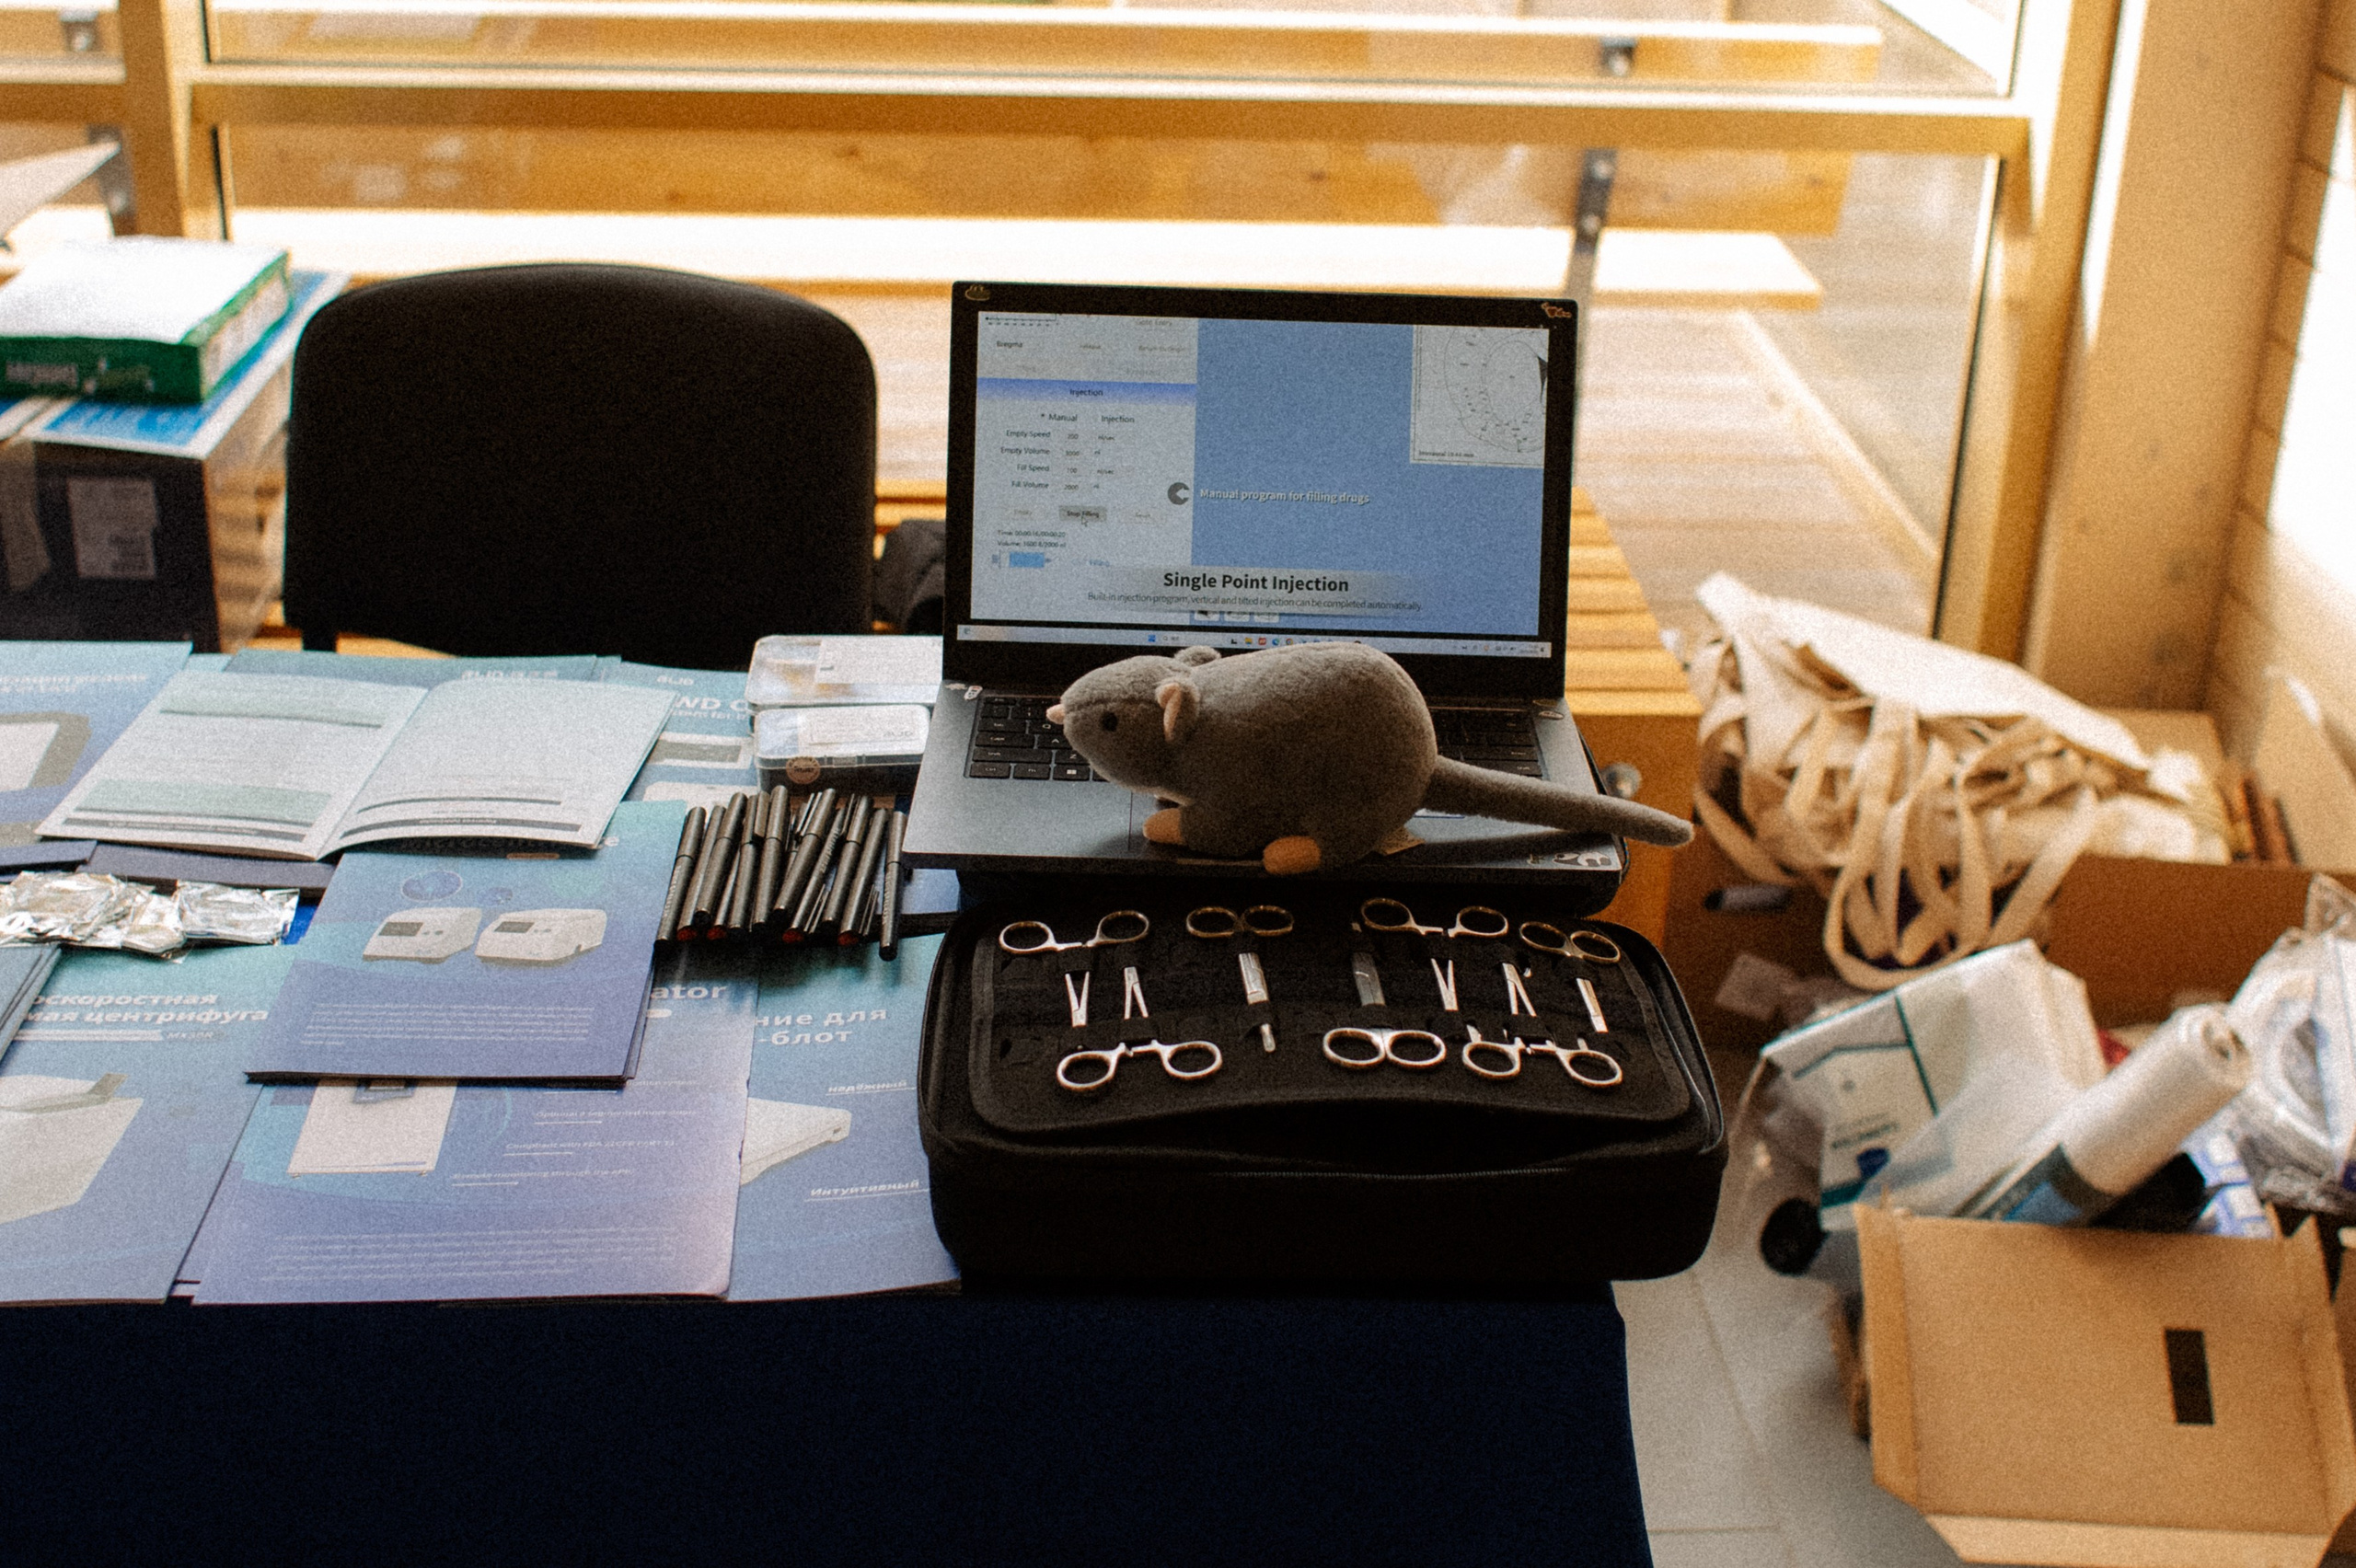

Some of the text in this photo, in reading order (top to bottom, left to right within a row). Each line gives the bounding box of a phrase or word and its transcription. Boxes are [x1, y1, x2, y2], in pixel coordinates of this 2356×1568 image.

[1069, 388, 1103, 398] Injection
[1048, 413, 1135, 424] Manual Injection
[1006, 430, 1028, 438] Empty
[1029, 431, 1051, 439] Speed
[1000, 446, 1022, 455] Empty
[1200, 489, 1370, 504] Manual program for filling drugs
[1163, 571, 1349, 594] Single Point Injection
[1117, 594, 1152, 604] injection
[1191, 595, 1220, 605] vertical
[1221, 596, 1237, 605] and
[1238, 596, 1258, 605] tilted
[1260, 597, 1296, 607] injection
[1311, 599, 1322, 607] be
[1323, 599, 1366, 609] completed
[650, 985, 727, 999] ator
[84, 1009, 270, 1025] центрифуга
[823, 1009, 888, 1026] для
[810, 1179, 919, 1196] Интуитивный
